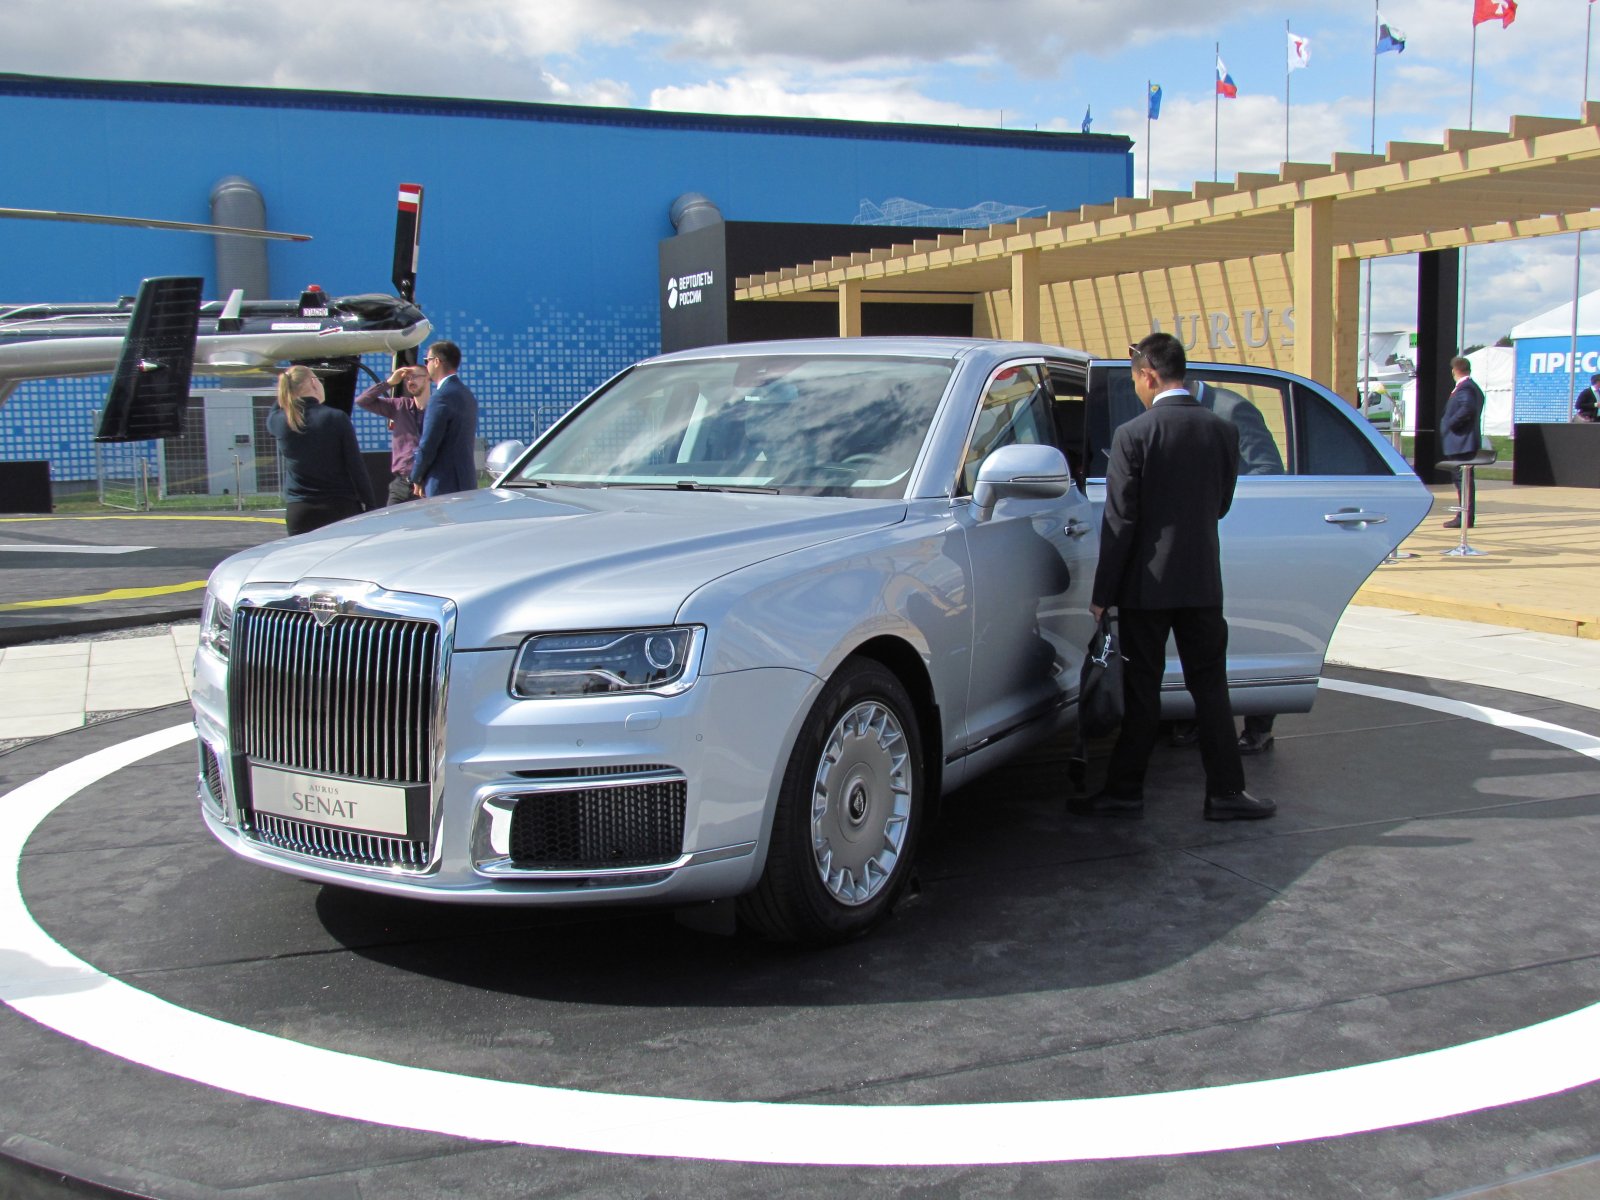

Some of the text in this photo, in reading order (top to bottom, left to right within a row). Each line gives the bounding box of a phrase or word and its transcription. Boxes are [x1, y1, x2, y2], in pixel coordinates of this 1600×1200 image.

[679, 271, 713, 290] ВЕРТОЛЕТЫ
[679, 289, 702, 306] РОССИИ
[1529, 351, 1600, 374] ПРЕС
[308, 784, 339, 795] AURUS
[292, 792, 358, 819] SENAT
